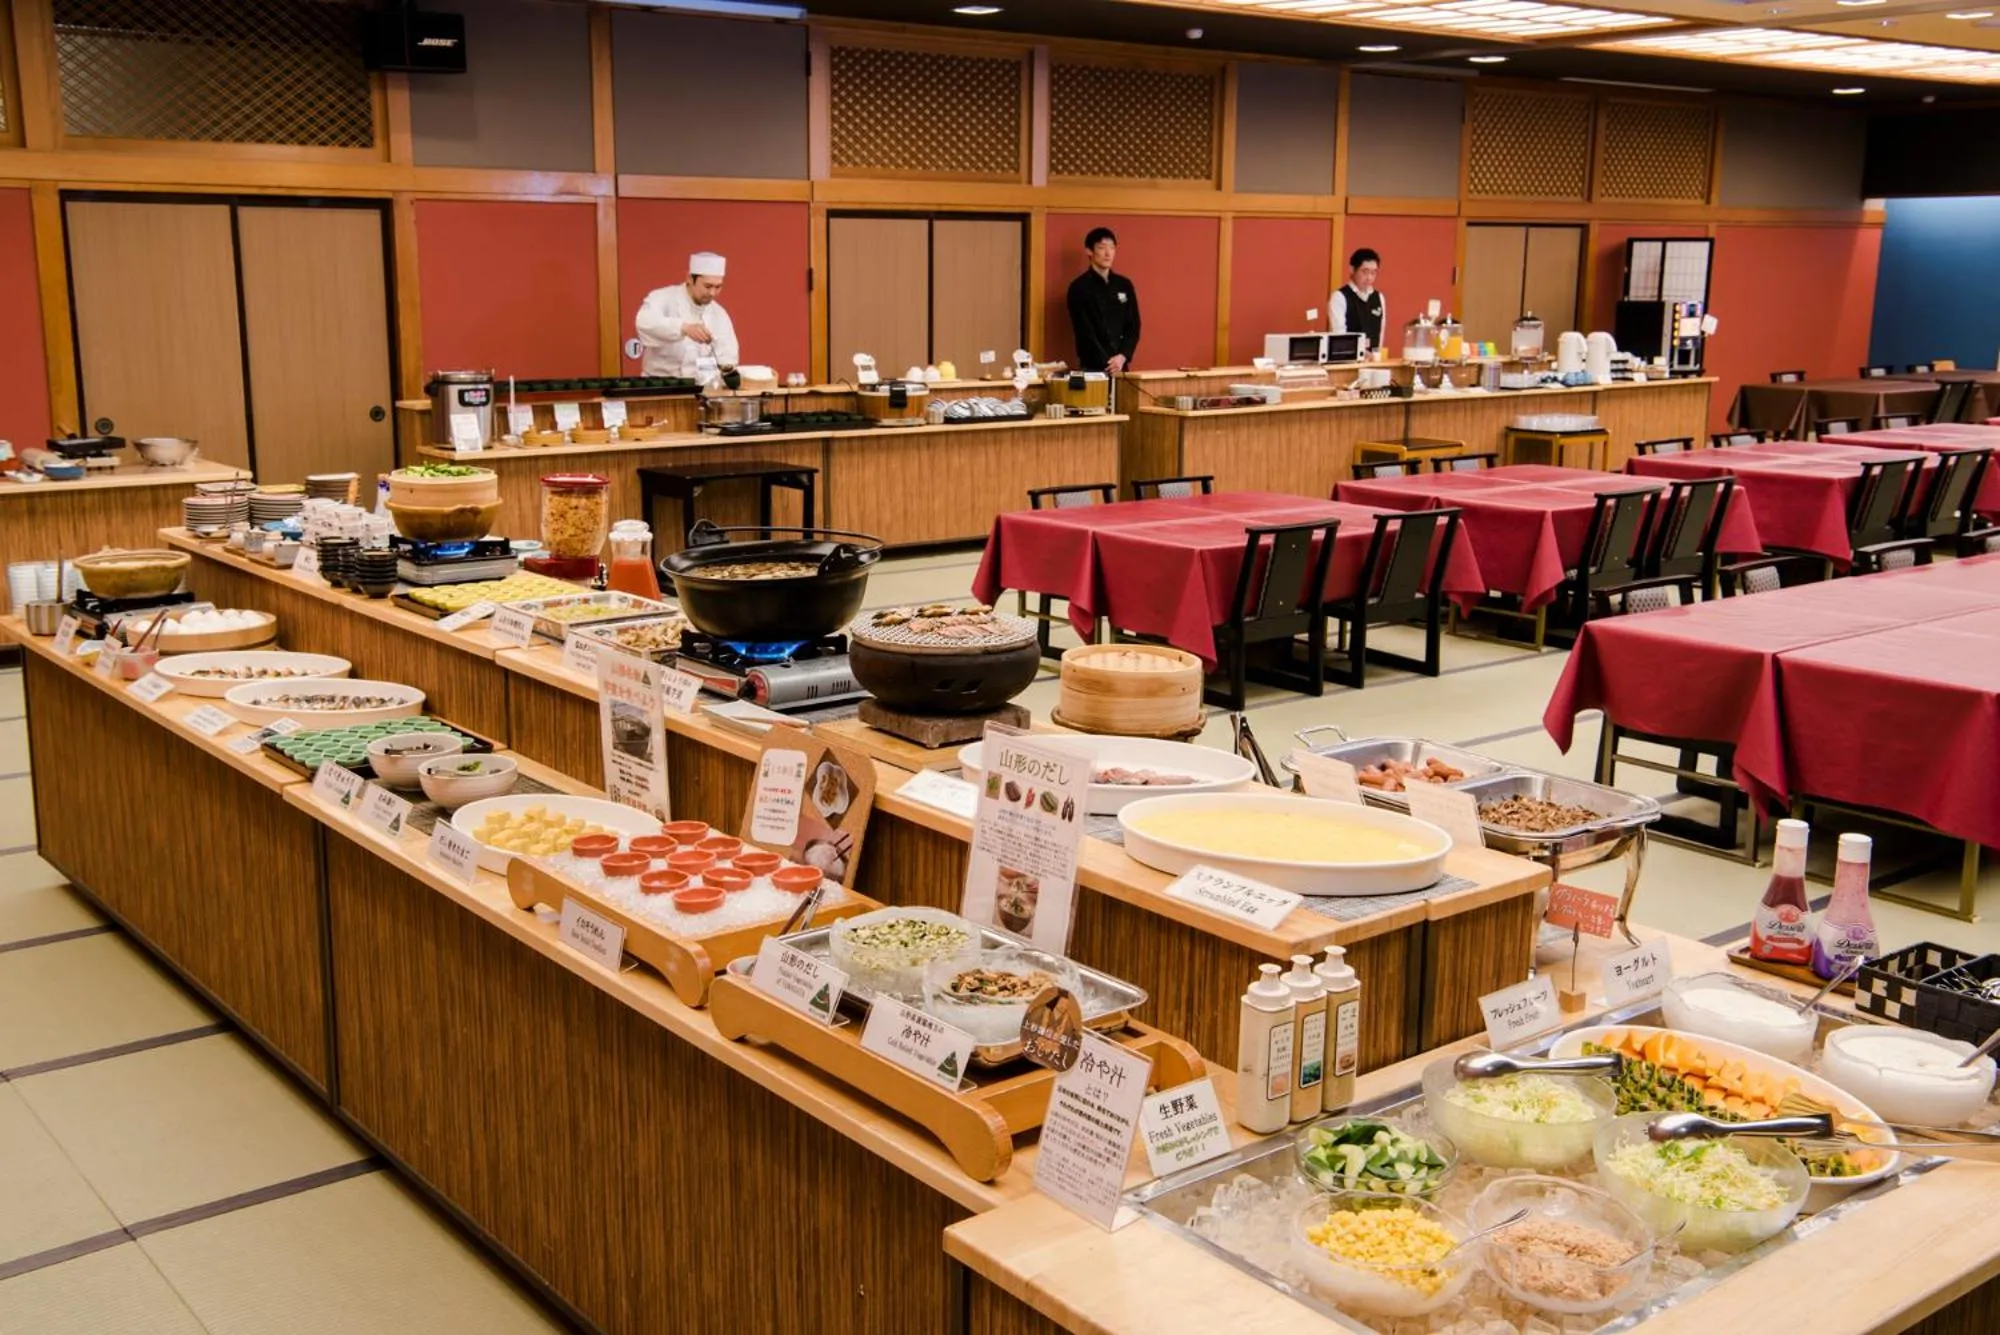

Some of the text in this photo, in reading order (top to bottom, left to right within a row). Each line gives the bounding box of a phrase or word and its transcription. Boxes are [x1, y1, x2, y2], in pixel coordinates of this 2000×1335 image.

[999, 749, 1069, 785] 山形のだし
[1832, 938, 1874, 950] Dessert
[780, 951, 819, 979] 山形のだし
[1614, 952, 1657, 976] ヨーグルト
[901, 1024, 932, 1048] 冷や汁
[1079, 1050, 1127, 1088] 冷や汁
[1159, 1093, 1199, 1121] 生野菜
[1148, 1111, 1218, 1143] Fresh Vegetables
